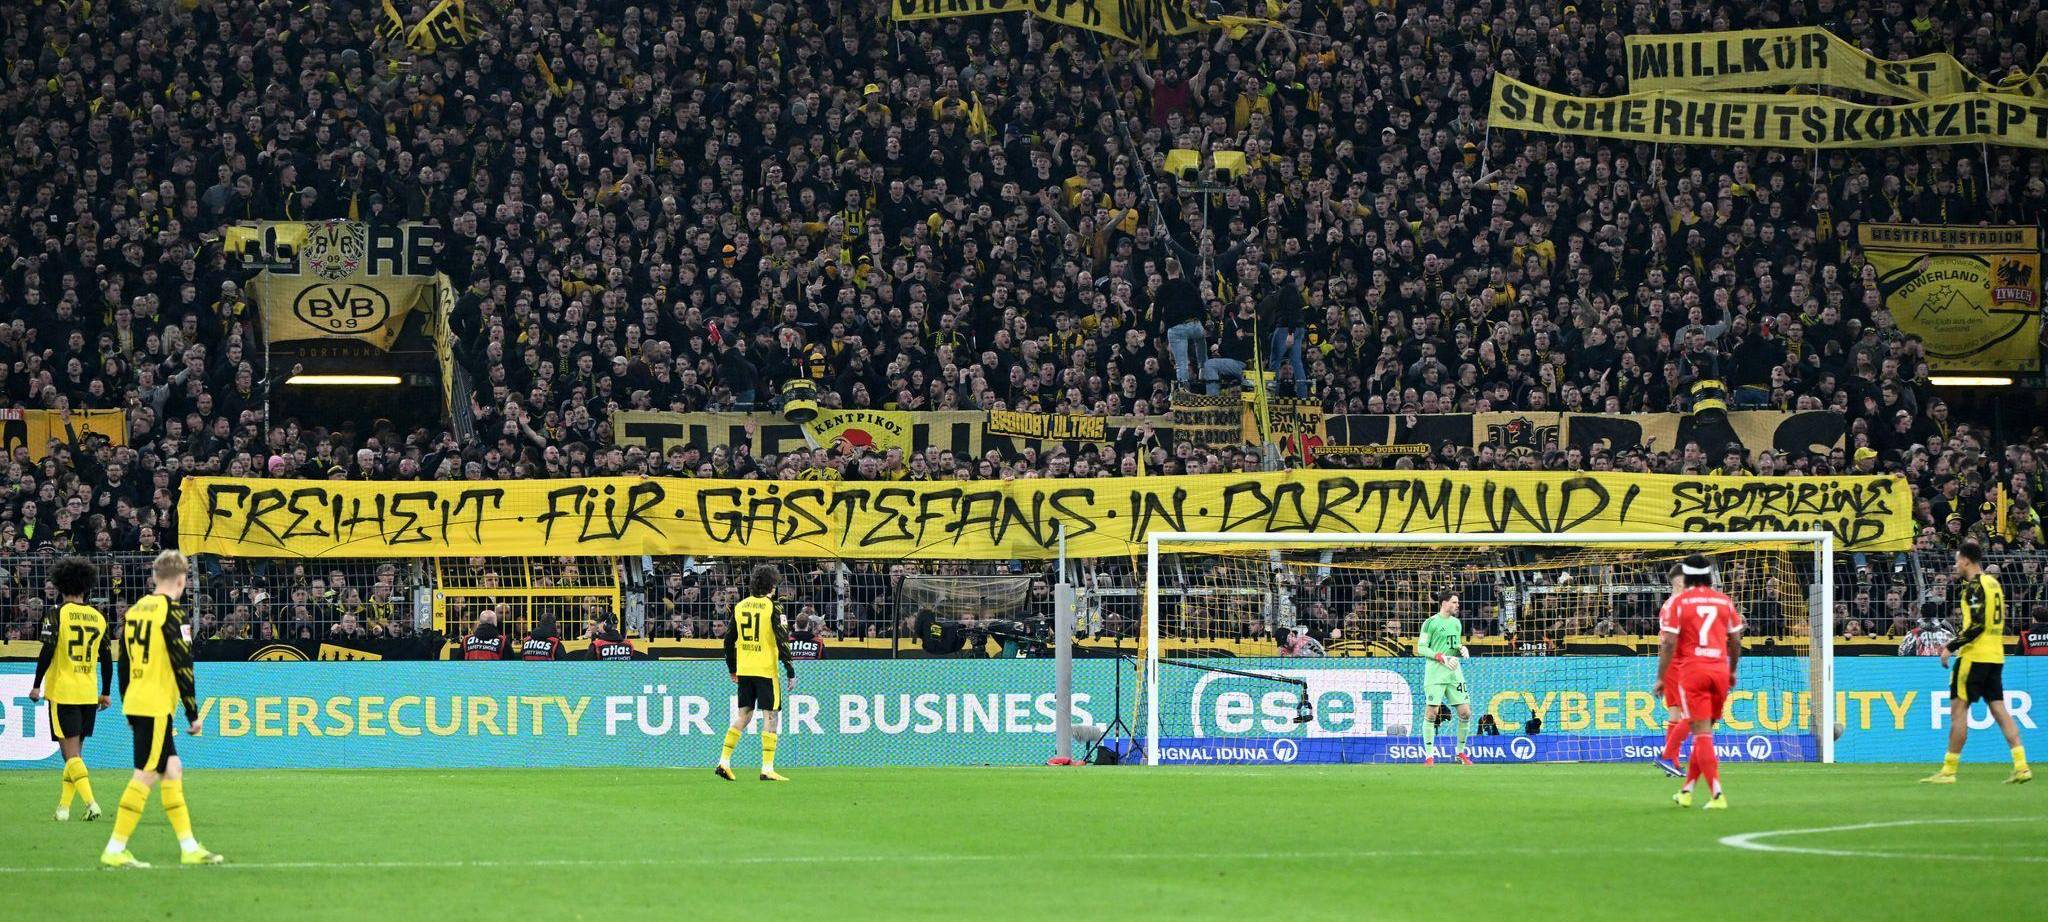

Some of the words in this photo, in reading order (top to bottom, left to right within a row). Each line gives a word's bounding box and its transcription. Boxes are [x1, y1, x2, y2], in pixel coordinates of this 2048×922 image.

[1633, 33, 1828, 79] WILLKÜR
[1865, 60, 1937, 96] IST
[1500, 83, 2048, 144] SICHERHEITSKONZEPT
[1899, 269, 1980, 299] POWERLAND
[308, 287, 375, 318] BVB
[329, 318, 358, 329] 09
[1376, 445, 1427, 454] DORTMUND
[203, 483, 505, 547] FREIHEIT
[537, 481, 668, 547] FÜR
[696, 484, 1096, 549] GÄSTEFANS
[1129, 486, 1188, 542] IN
[126, 618, 152, 664] 24
[740, 611, 760, 642] 21
[1696, 605, 1718, 646] 7
[68, 625, 100, 662] 27
[523, 638, 551, 650] atlas
[602, 645, 631, 656] atlas
[172, 696, 592, 737] YBERSECURITY
[605, 684, 714, 737] FÜR
[1486, 690, 1920, 733] CYBERCURITY
[1216, 748, 1268, 760] IDUNA
[1624, 745, 1687, 758] SIGN
